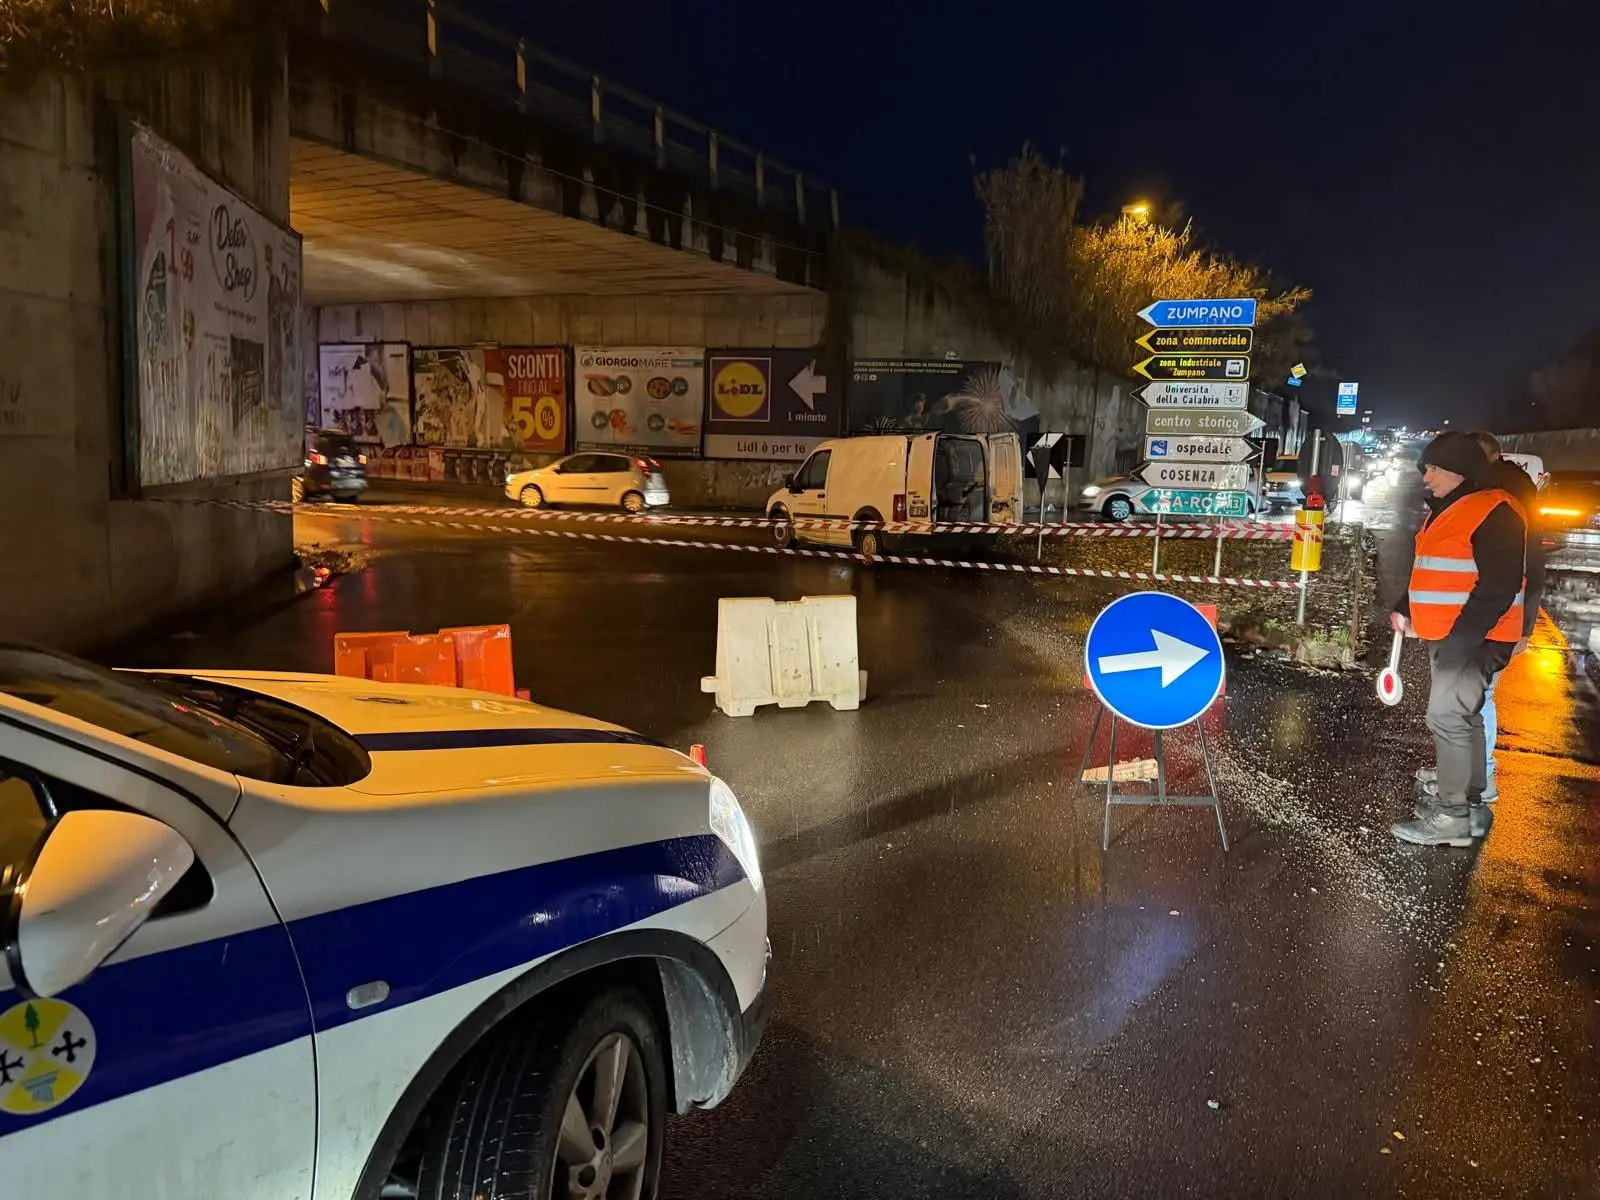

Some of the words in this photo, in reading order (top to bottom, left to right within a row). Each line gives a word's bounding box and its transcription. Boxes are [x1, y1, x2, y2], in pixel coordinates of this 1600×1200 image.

[1167, 306, 1243, 319] ZUMPANO
[1156, 336, 1178, 346] zona
[1183, 333, 1247, 346] commerciale
[1159, 359, 1176, 367] zona
[1179, 358, 1222, 367] industriale
[1172, 368, 1206, 377] Zumpano
[1156, 395, 1178, 404] della
[1182, 395, 1219, 405] Calabria
[795, 412, 827, 422] minuto
[1154, 416, 1191, 428] centro
[1198, 415, 1239, 428] storico
[737, 441, 758, 452] Lidl
[761, 442, 768, 452] è
[772, 444, 791, 455] per
[795, 443, 806, 453] te
[1176, 441, 1231, 455] ospedale
[1160, 469, 1216, 482] COSENZA
